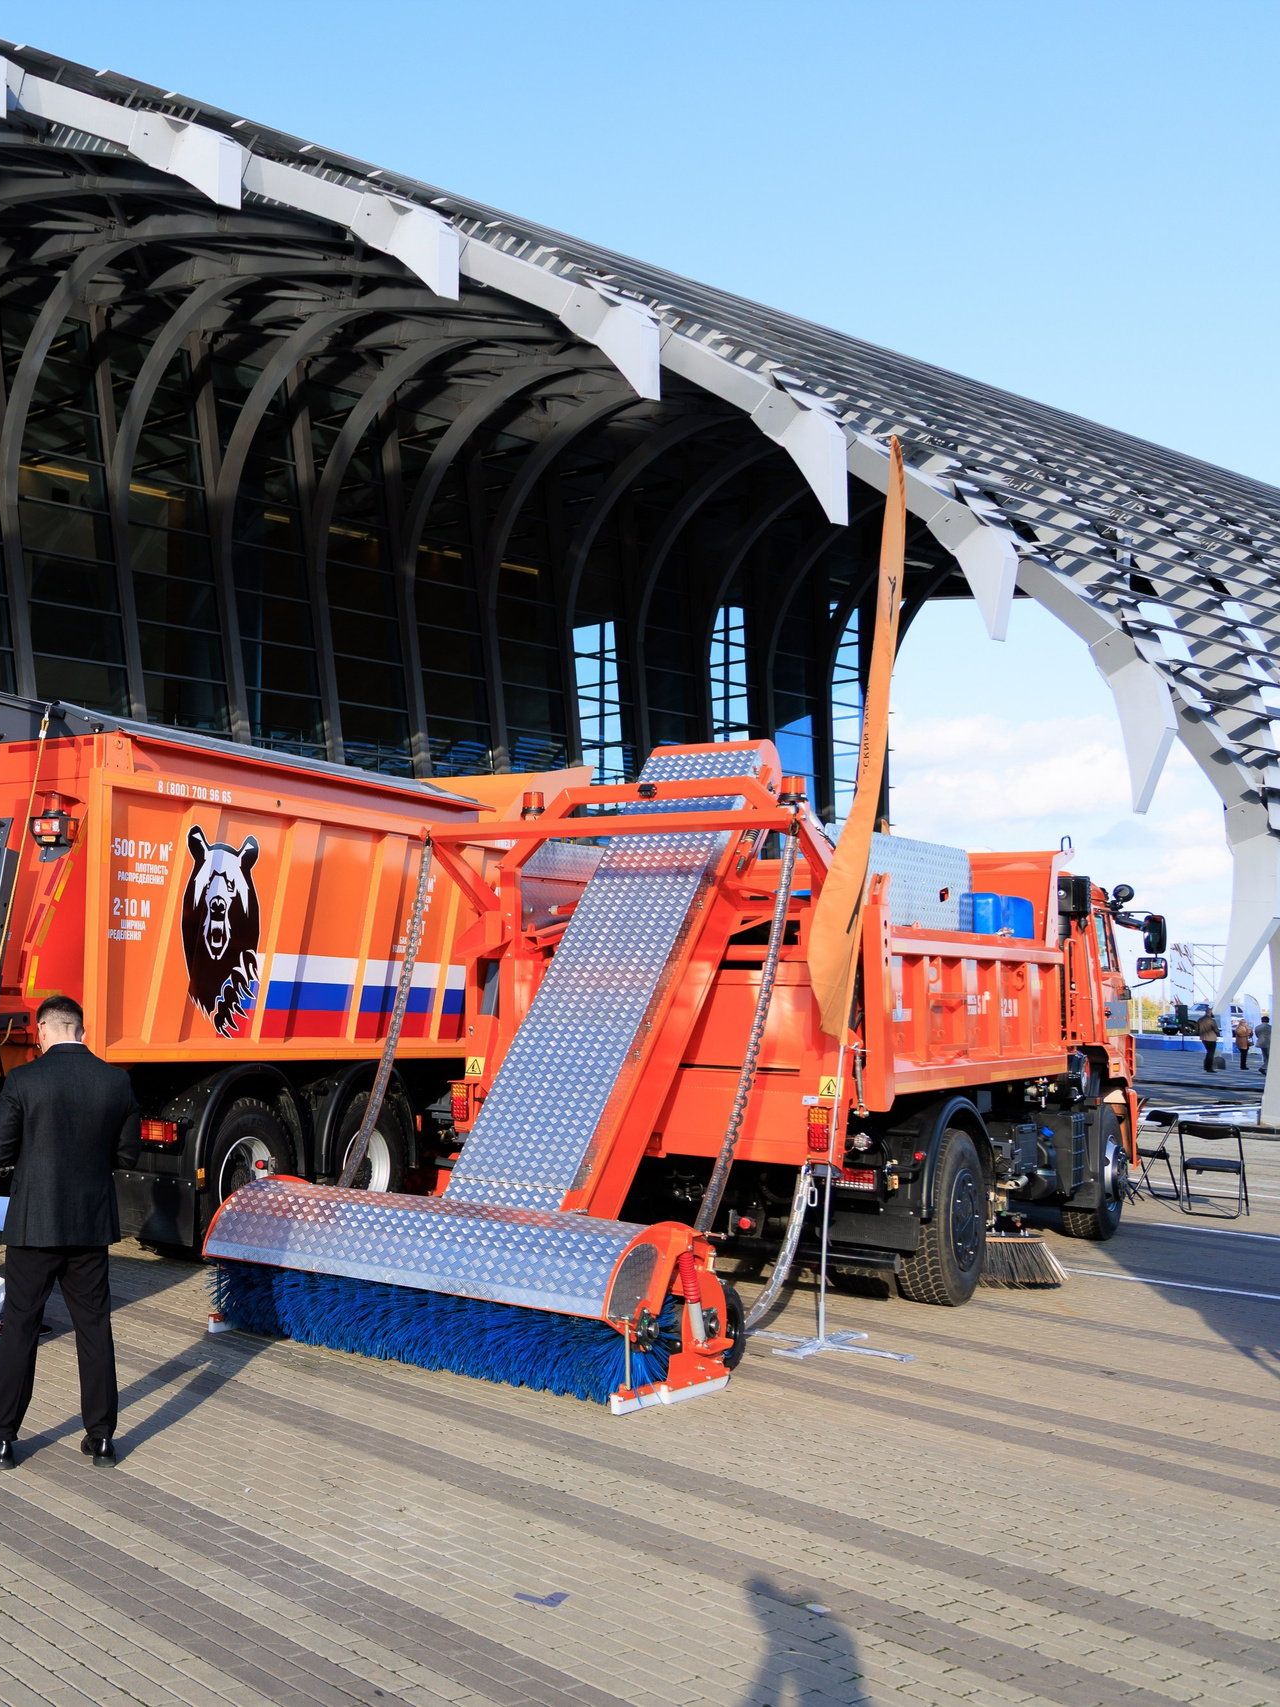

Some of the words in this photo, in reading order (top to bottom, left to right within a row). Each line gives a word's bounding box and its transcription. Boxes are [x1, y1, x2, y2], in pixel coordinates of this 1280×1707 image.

[158, 780, 163, 793] 8
[166, 781, 189, 797] (800)
[192, 786, 207, 799] 700
[210, 789, 219, 801] 96
[222, 791, 231, 804] 65
[135, 862, 169, 875] ПЛОТНОСТЬ
[117, 871, 164, 885] РАСПРЕДЕЛЕНИЯ
[113, 897, 137, 917] 2-10
[140, 900, 150, 918] М
[121, 919, 146, 930] ШИРИНА
